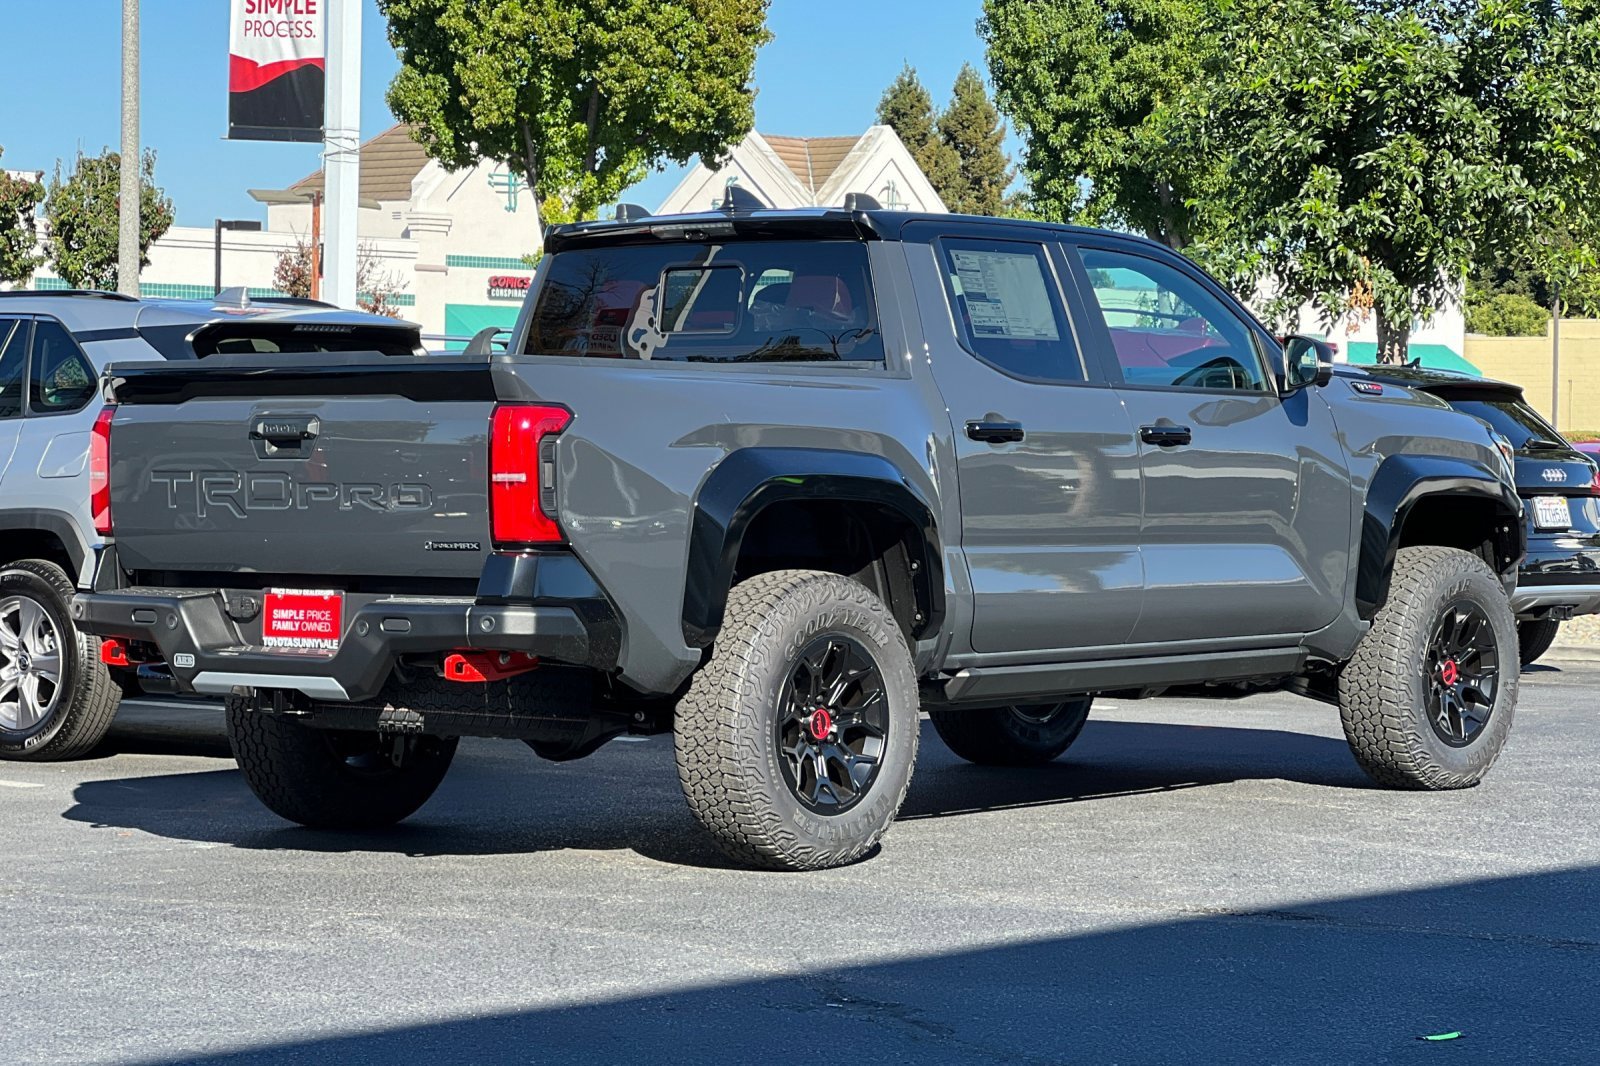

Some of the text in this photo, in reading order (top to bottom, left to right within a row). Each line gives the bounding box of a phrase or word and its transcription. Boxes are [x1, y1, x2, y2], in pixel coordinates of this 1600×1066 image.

[244, 20, 316, 38] PROCESS.
[488, 275, 531, 289] COMICS
[273, 609, 332, 621] SIMPLE PRICE.
[272, 620, 332, 632] FAMILY OWNED.
